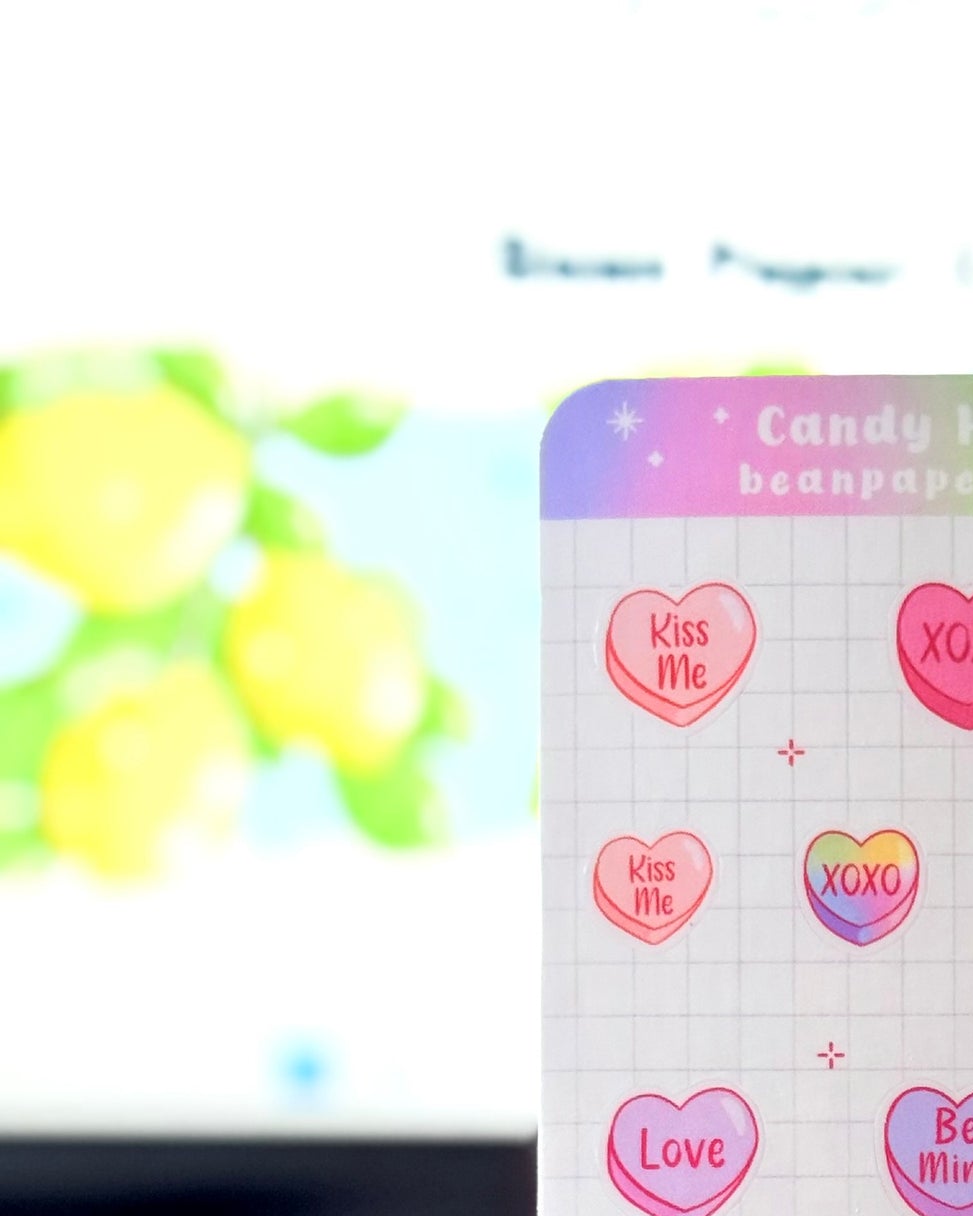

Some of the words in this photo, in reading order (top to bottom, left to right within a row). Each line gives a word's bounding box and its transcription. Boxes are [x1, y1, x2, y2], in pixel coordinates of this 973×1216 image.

[757, 405, 932, 452] Candy
[650, 612, 709, 647] Kiss
[657, 653, 708, 690] Me
[628, 854, 676, 884] Kiss
[820, 862, 901, 897] XOXO
[634, 887, 673, 917] Me
[640, 1127, 726, 1170] Love
